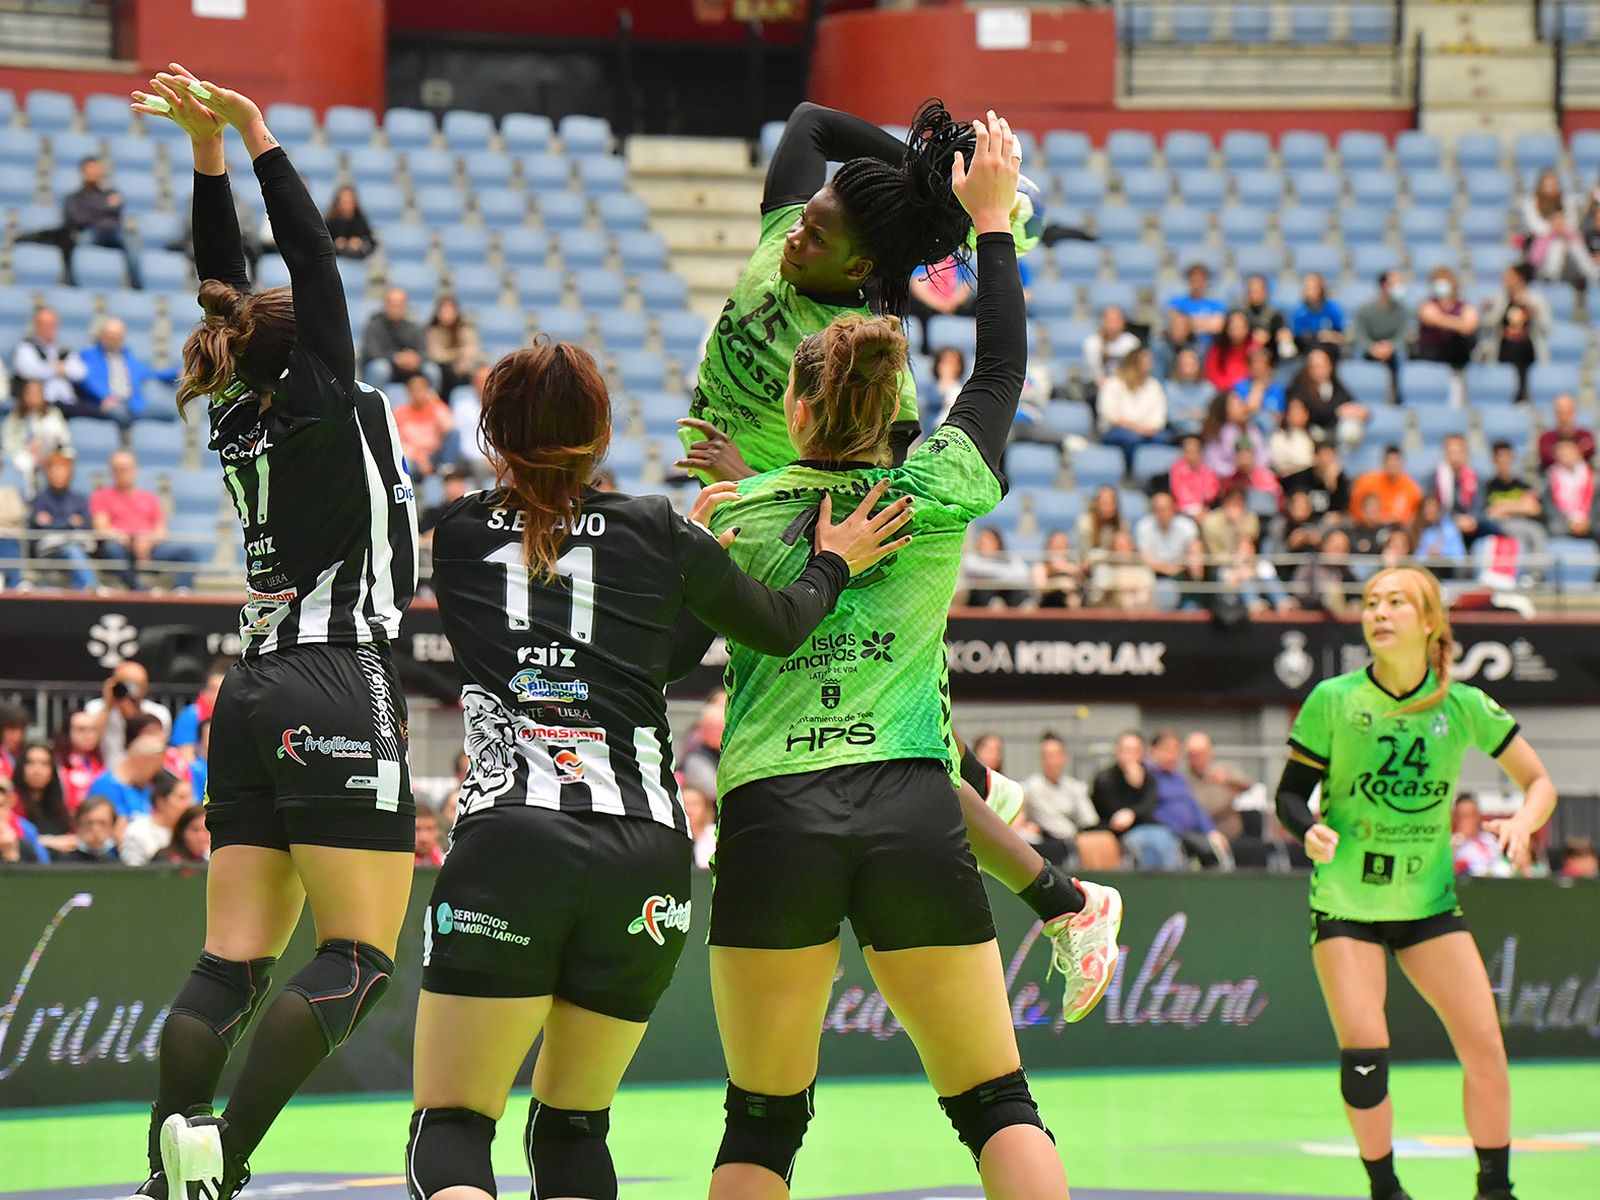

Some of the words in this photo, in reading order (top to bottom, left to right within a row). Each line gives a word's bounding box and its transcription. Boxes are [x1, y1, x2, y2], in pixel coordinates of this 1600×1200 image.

[482, 540, 596, 645] 11
[516, 641, 577, 668] raíz
[811, 632, 857, 652] Islas
[844, 712, 855, 723] de
[304, 736, 372, 755] frigiliana
[785, 722, 877, 752] HPS
[1376, 735, 1430, 777] 24
[1350, 771, 1450, 808] Rocasa
[453, 908, 509, 931] SERVICIOS
